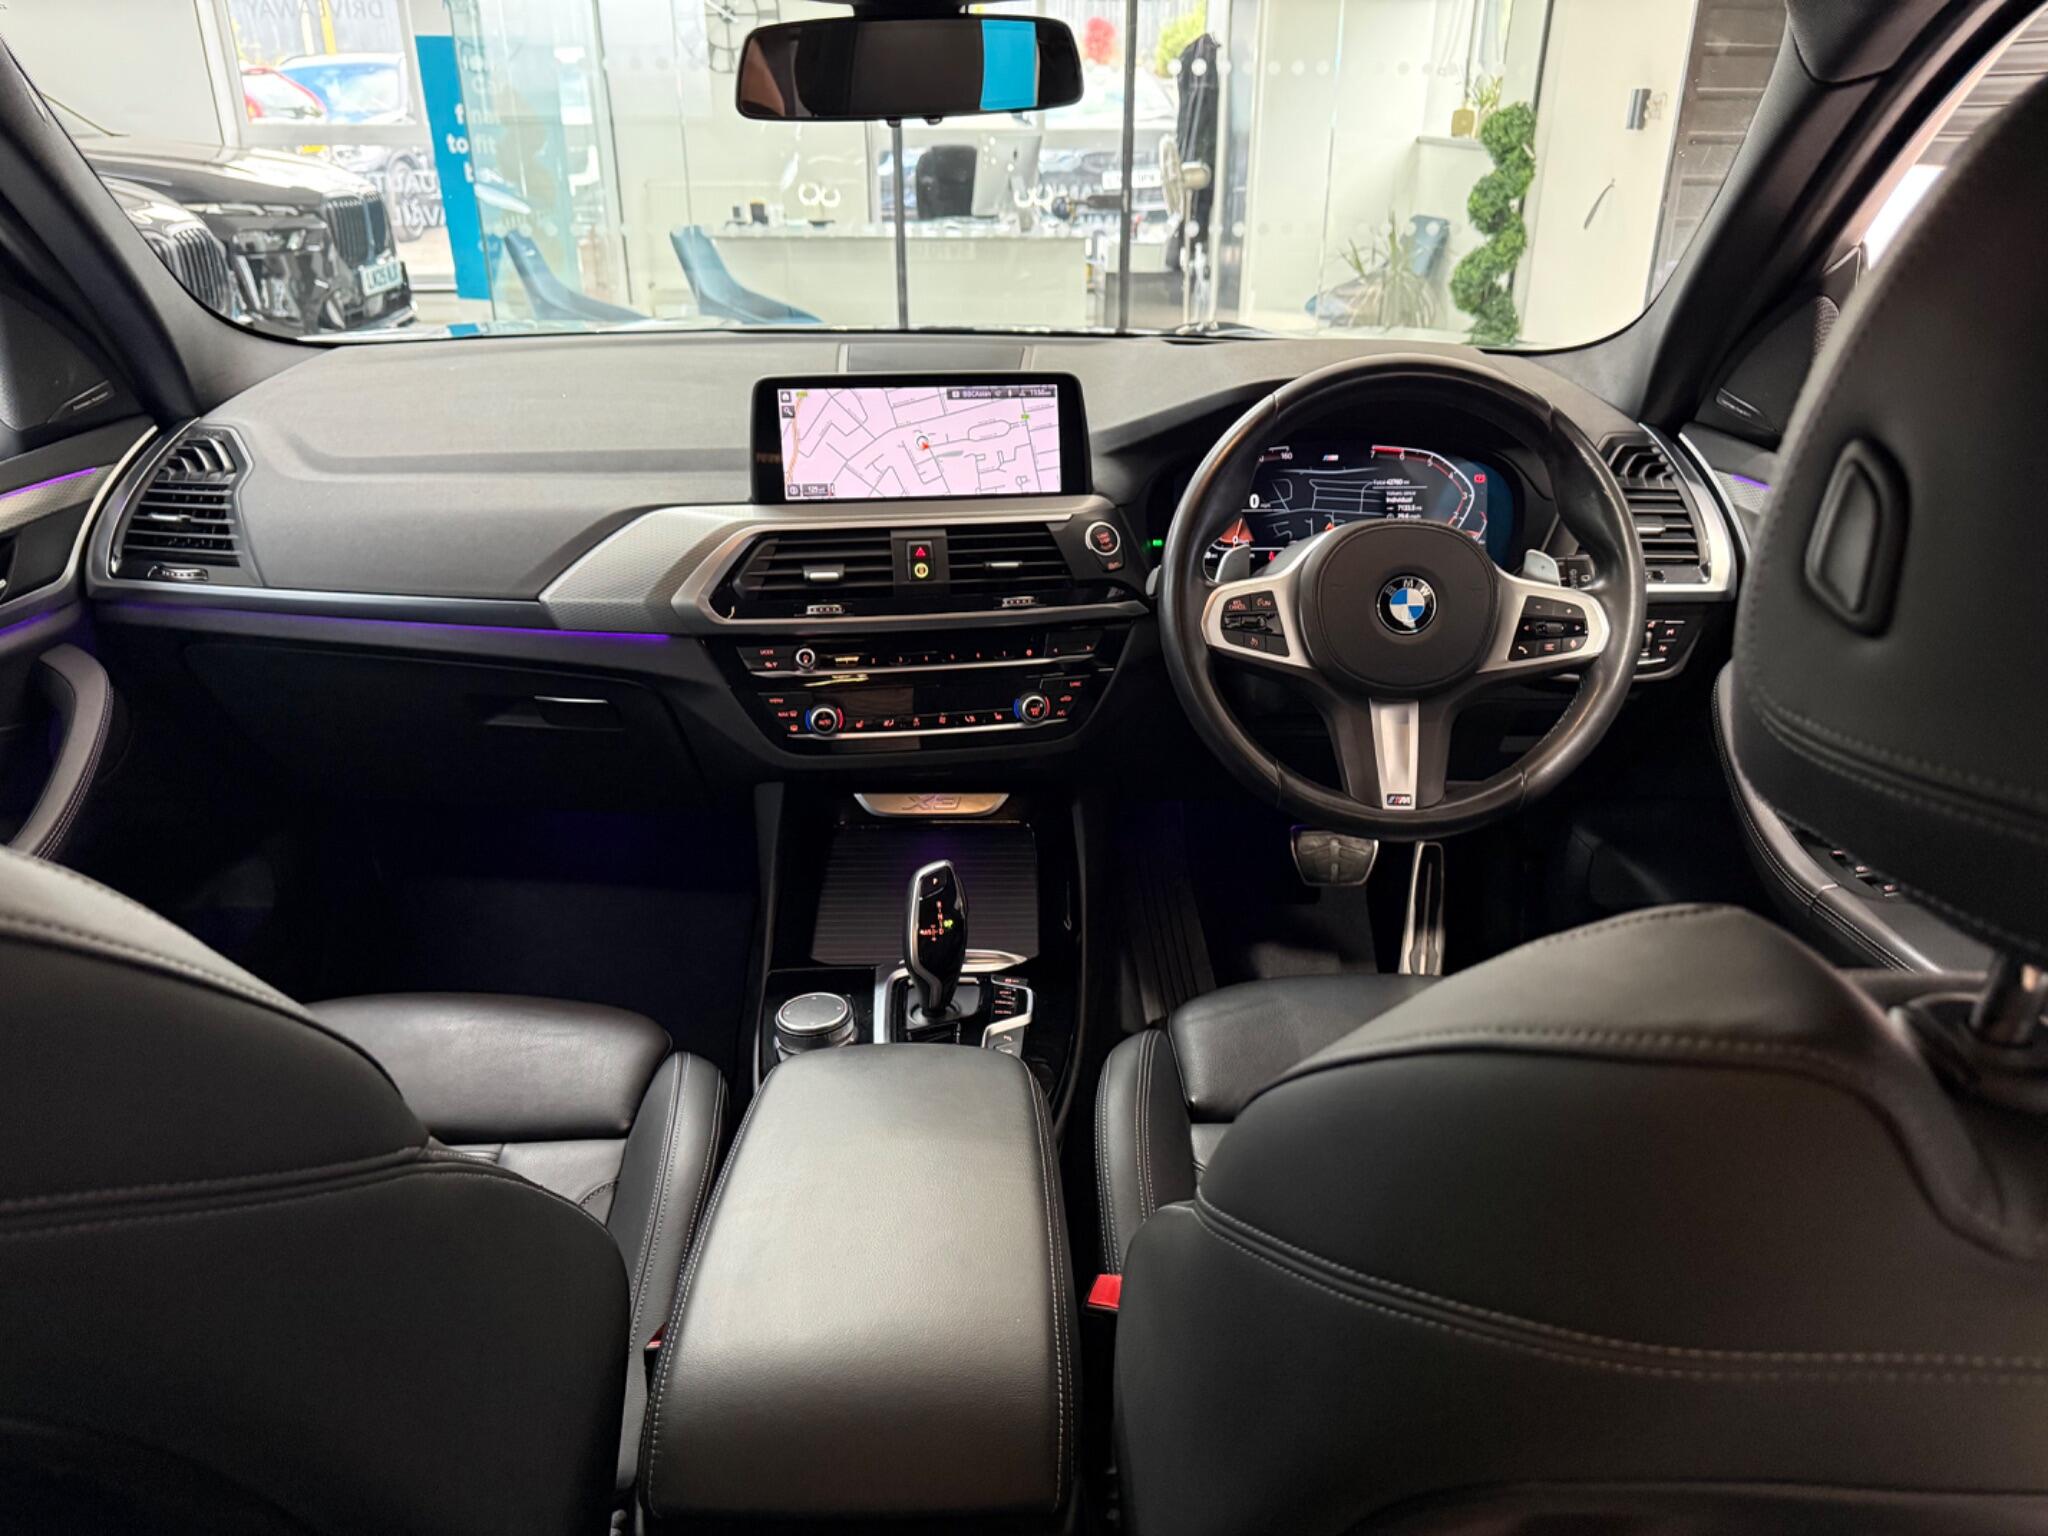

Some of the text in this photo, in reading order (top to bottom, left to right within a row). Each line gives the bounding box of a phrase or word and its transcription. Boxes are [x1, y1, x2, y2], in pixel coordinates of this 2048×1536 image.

[447, 133, 468, 154] to
[1249, 493, 1260, 509] 0
[1385, 578, 1432, 597] BMW
